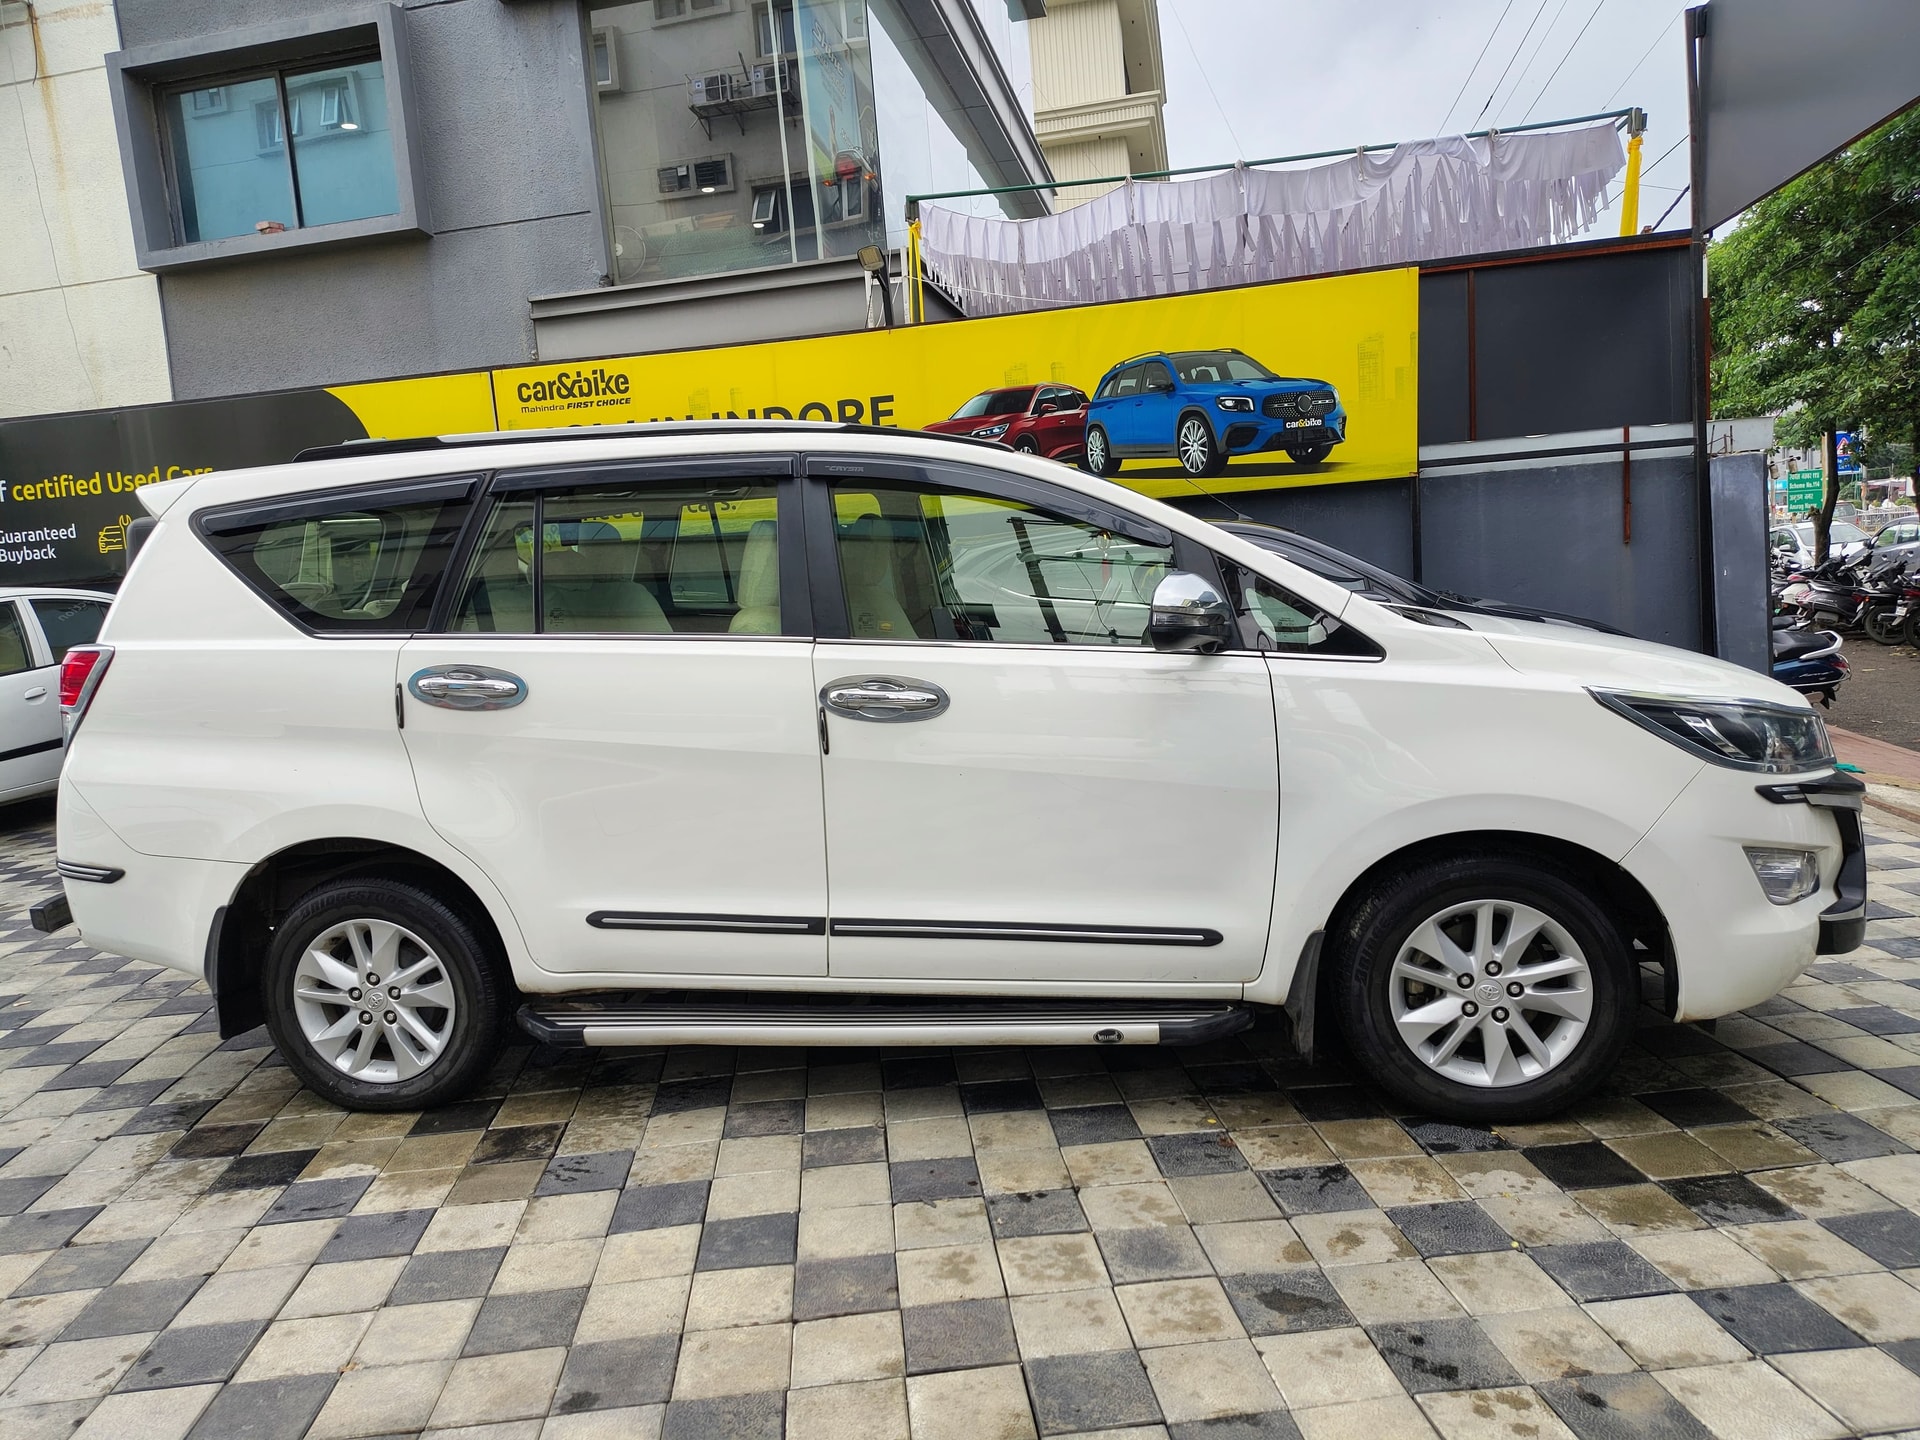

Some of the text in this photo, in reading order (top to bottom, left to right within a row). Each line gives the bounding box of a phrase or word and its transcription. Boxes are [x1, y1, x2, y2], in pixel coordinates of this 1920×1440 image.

[517, 369, 630, 403] car&bike
[521, 397, 631, 413] Mahindra FIRST CHOICE
[1286, 418, 1322, 428] car&bike
[12, 472, 102, 501] certified
[106, 465, 160, 493] Used
[0, 544, 57, 564] Buyback
